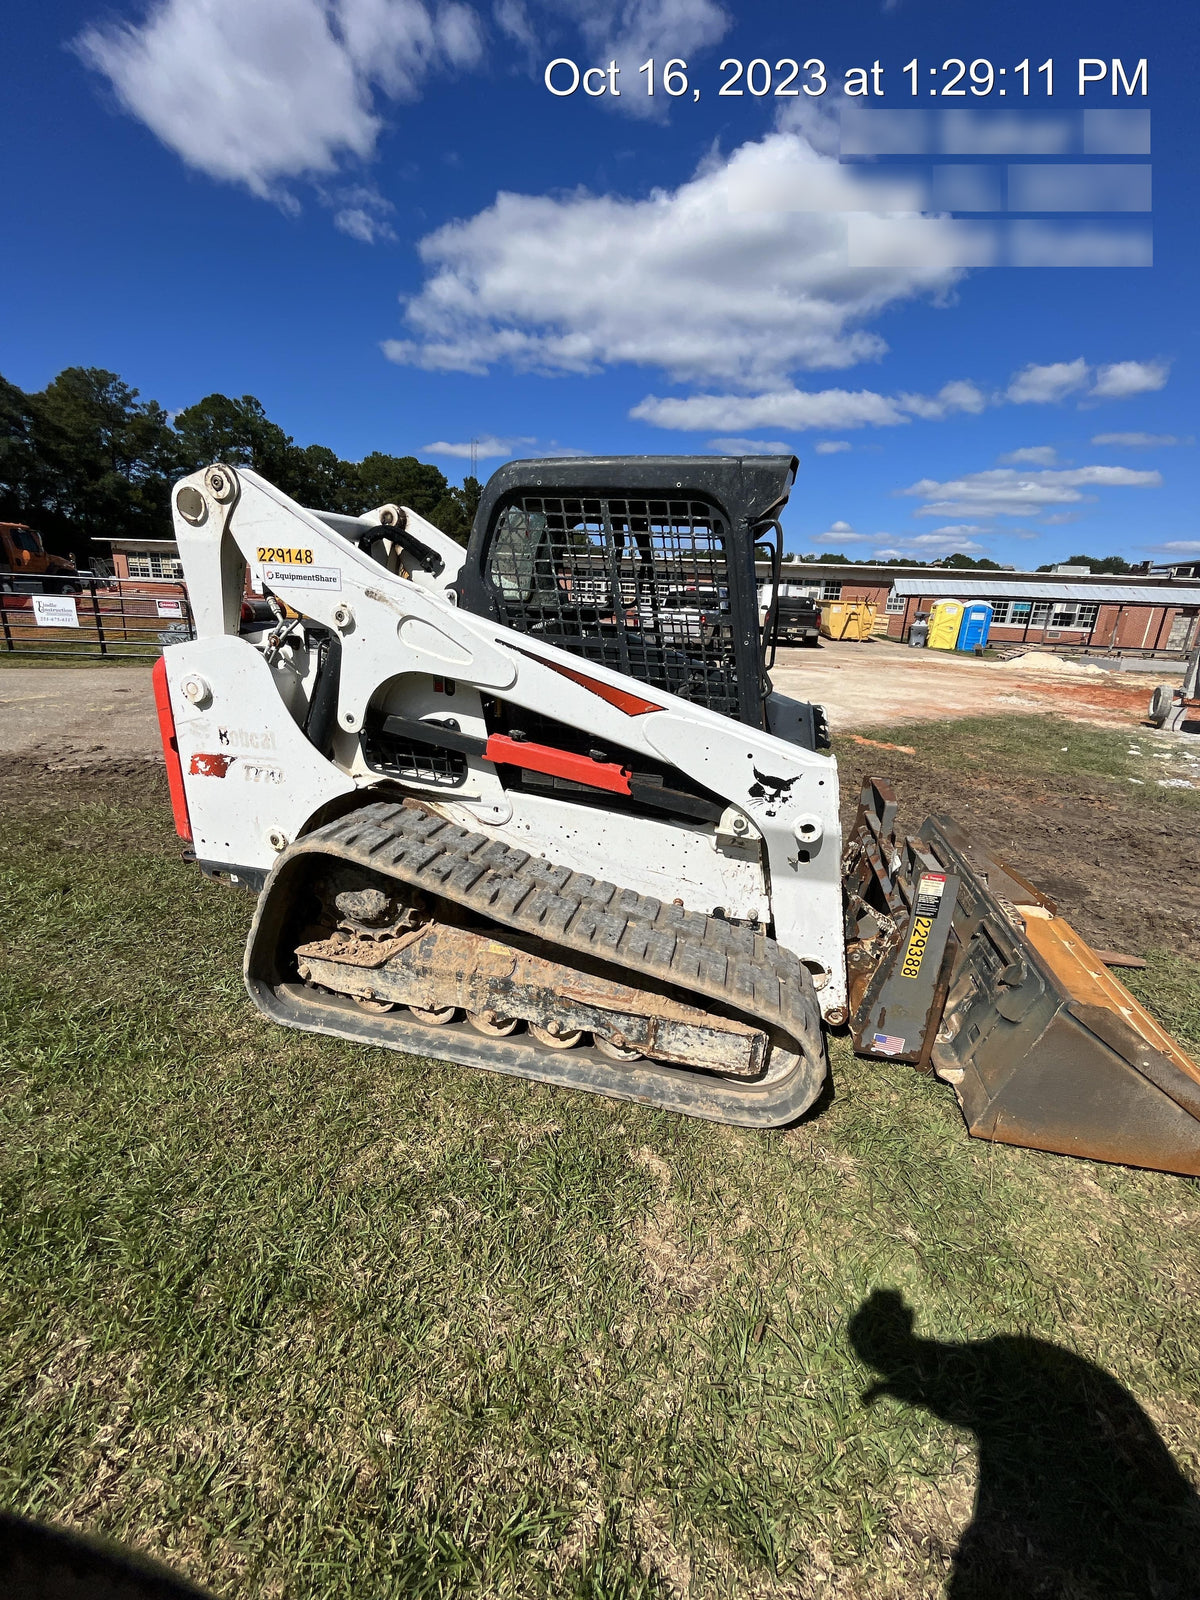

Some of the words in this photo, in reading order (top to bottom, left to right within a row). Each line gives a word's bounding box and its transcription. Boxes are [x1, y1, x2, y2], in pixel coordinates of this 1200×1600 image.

[258, 547, 313, 564] 229148
[275, 572, 337, 583] EquipmentShare
[903, 918, 931, 976] 229388
